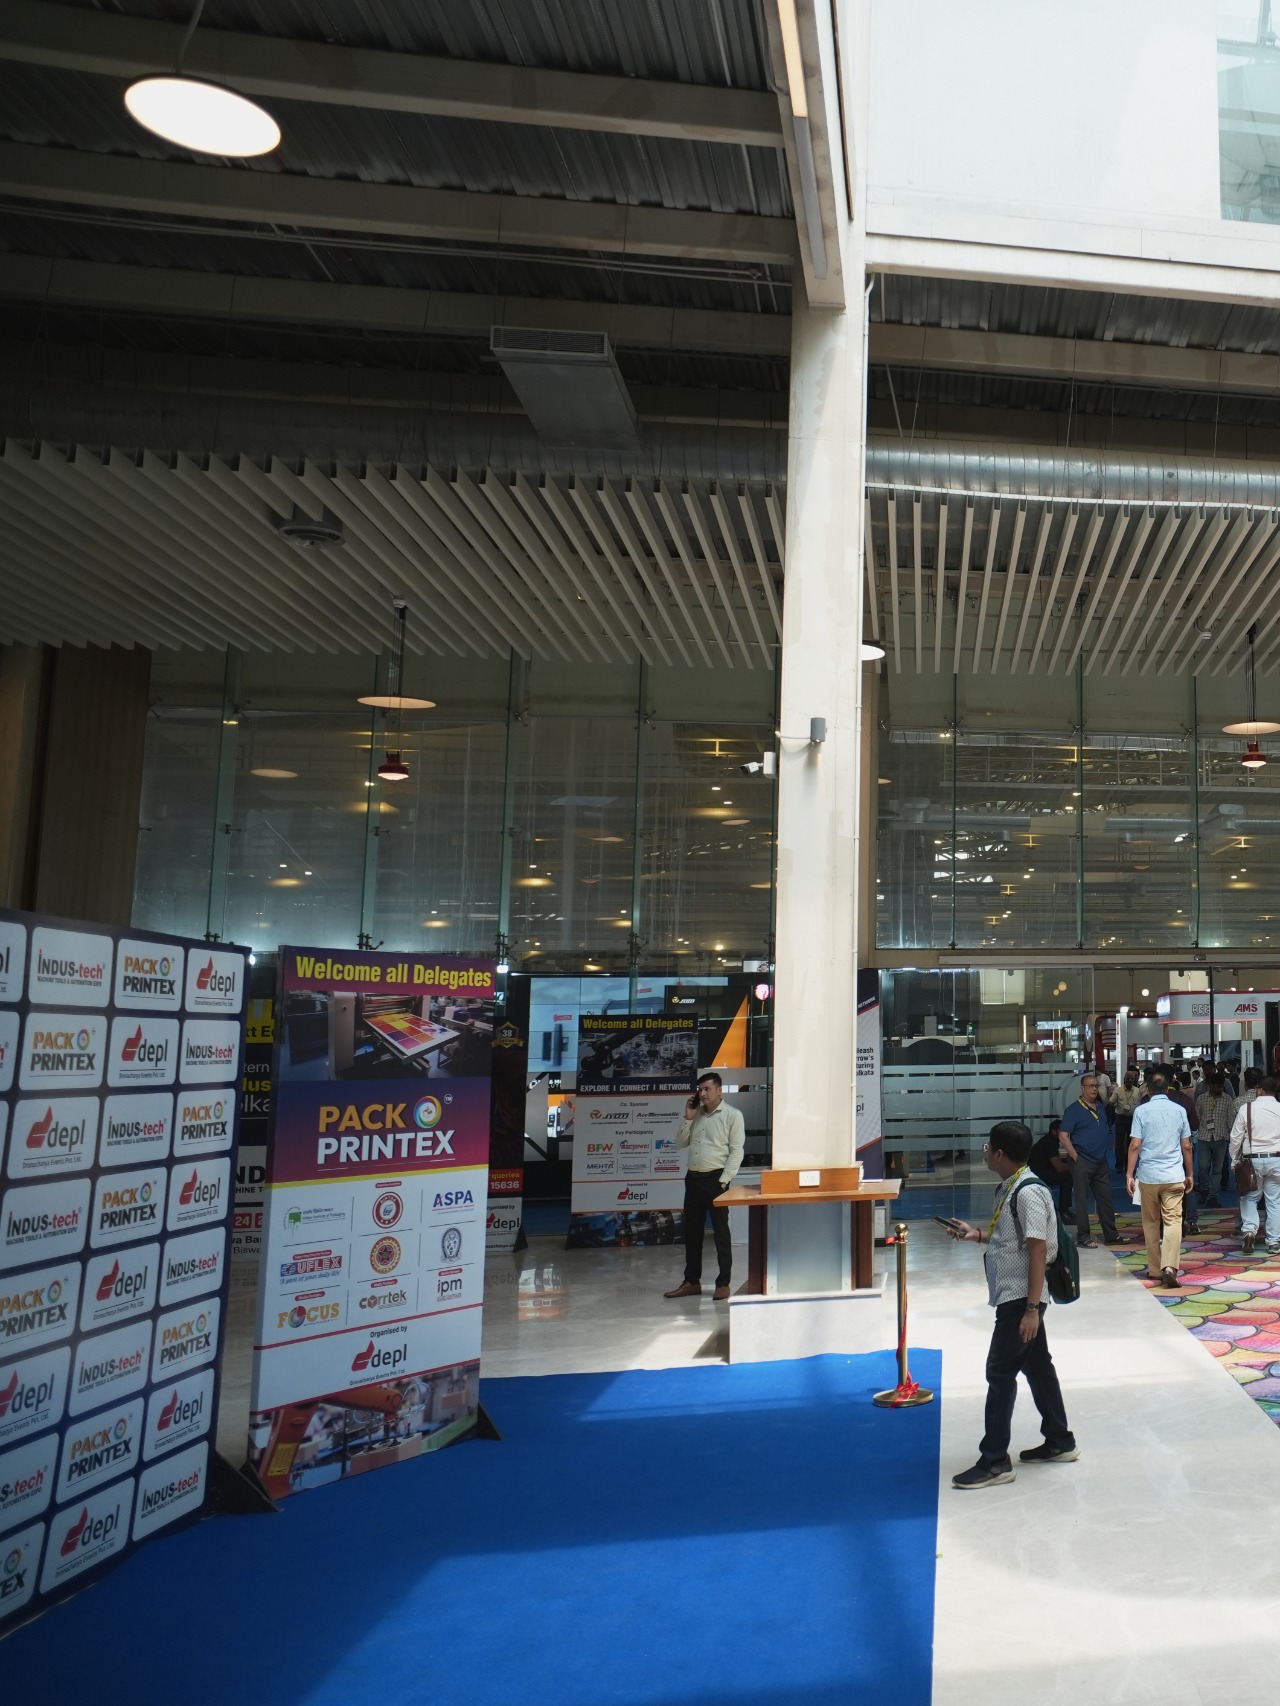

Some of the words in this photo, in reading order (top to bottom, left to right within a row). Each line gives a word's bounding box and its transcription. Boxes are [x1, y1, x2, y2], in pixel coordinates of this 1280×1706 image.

[124, 955, 158, 975] PACK
[296, 956, 381, 983] Welcome
[387, 964, 408, 984] all
[414, 964, 492, 990] Delegates
[123, 975, 175, 995] PRINTEX
[210, 971, 235, 997] depl
[1234, 1003, 1258, 1012] AMS
[502, 1029, 512, 1037] 38
[583, 1019, 628, 1029] Welcome
[630, 1019, 643, 1028] all
[645, 1018, 694, 1029] Delegates
[32, 1031, 75, 1050] PACK
[30, 1053, 96, 1071] PRINTEX
[138, 1039, 168, 1067] depl
[659, 1083, 691, 1091] NETWORK
[182, 1105, 212, 1122] PACK
[318, 1103, 408, 1133] PACK
[47, 1119, 86, 1153] depl
[181, 1120, 228, 1140] PRINTEX
[316, 1129, 456, 1165] PRINTEX
[587, 1143, 614, 1153] BFW
[490, 1181, 520, 1190] 15636
[491, 1171, 520, 1181] queries
[102, 1187, 139, 1209] PACK
[194, 1177, 221, 1206] depl
[433, 1190, 473, 1208] ASPA
[627, 1191, 648, 1201] depl
[100, 1203, 158, 1230] PRINTEX
[493, 1217, 519, 1230] depl
[297, 1257, 341, 1274] UFLEX
[114, 1266, 148, 1298] depl
[437, 1278, 462, 1296] ipm
[0, 1287, 46, 1317] PACK
[0, 1302, 69, 1337] PRINTEX
[162, 1321, 194, 1345] PACK
[370, 1326, 399, 1339] Organised
[400, 1325, 408, 1333] by
[160, 1332, 211, 1365] PRINTEX
[371, 1344, 407, 1368] depl
[11, 1373, 55, 1413] depl
[173, 1391, 204, 1425] depl
[71, 1427, 112, 1460] PACK
[67, 1437, 132, 1482] PRINTEX
[0, 1469, 43, 1500] S-tech
[81, 1504, 120, 1547] depl
